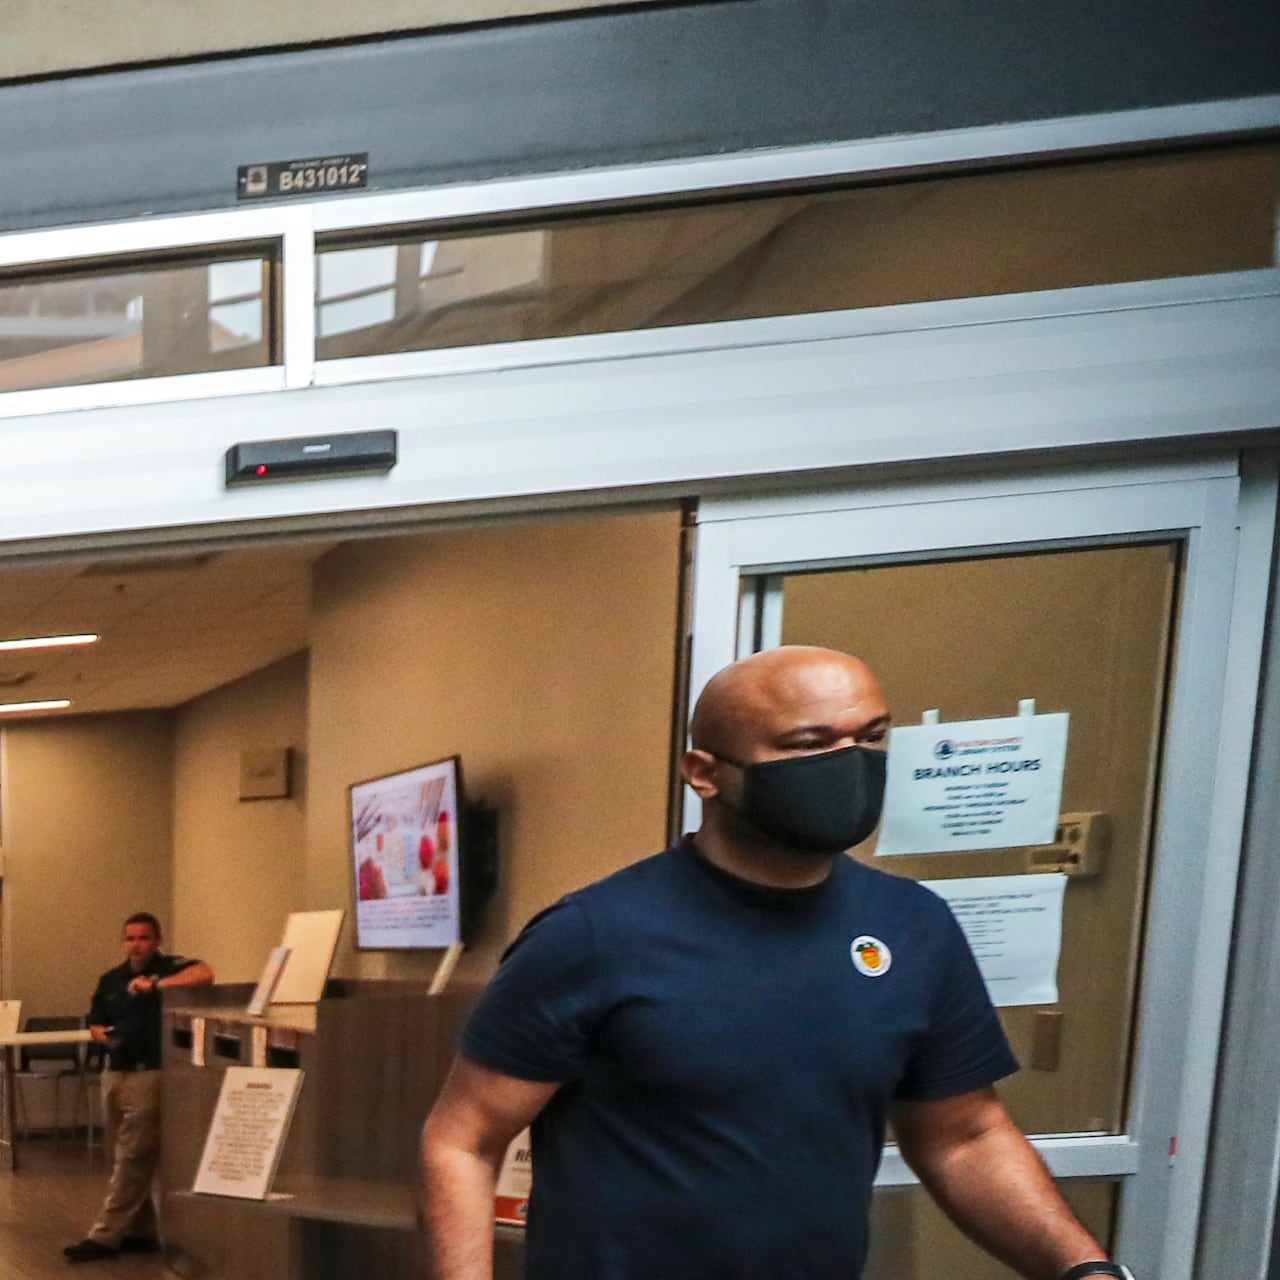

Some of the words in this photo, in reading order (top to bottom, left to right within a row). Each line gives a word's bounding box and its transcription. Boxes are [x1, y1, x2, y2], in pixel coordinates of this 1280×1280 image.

[280, 164, 360, 191] B431012
[912, 764, 981, 780] BRANCH
[985, 758, 1042, 775] HOURS
